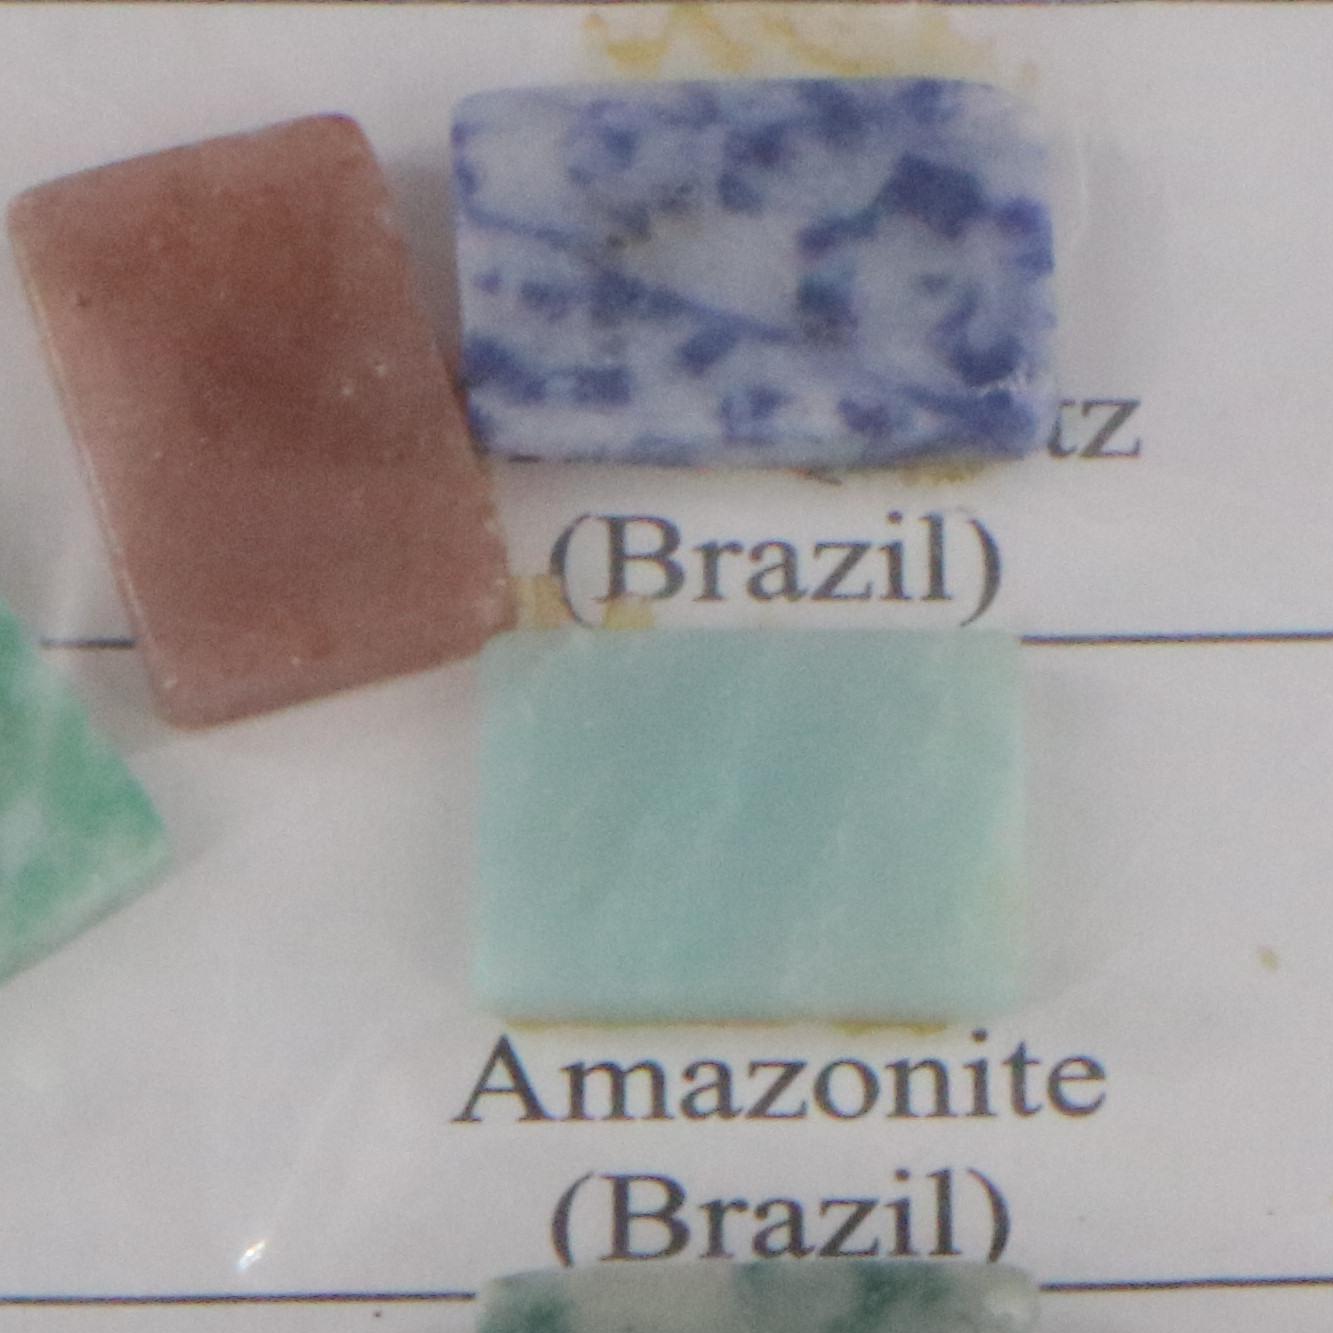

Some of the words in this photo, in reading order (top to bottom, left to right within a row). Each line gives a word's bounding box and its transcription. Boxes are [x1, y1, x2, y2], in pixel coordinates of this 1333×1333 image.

[548, 510, 1001, 627] (Brazil)
[450, 1028, 1108, 1124] Amazonite
[550, 1167, 1012, 1268] (Brazil)
